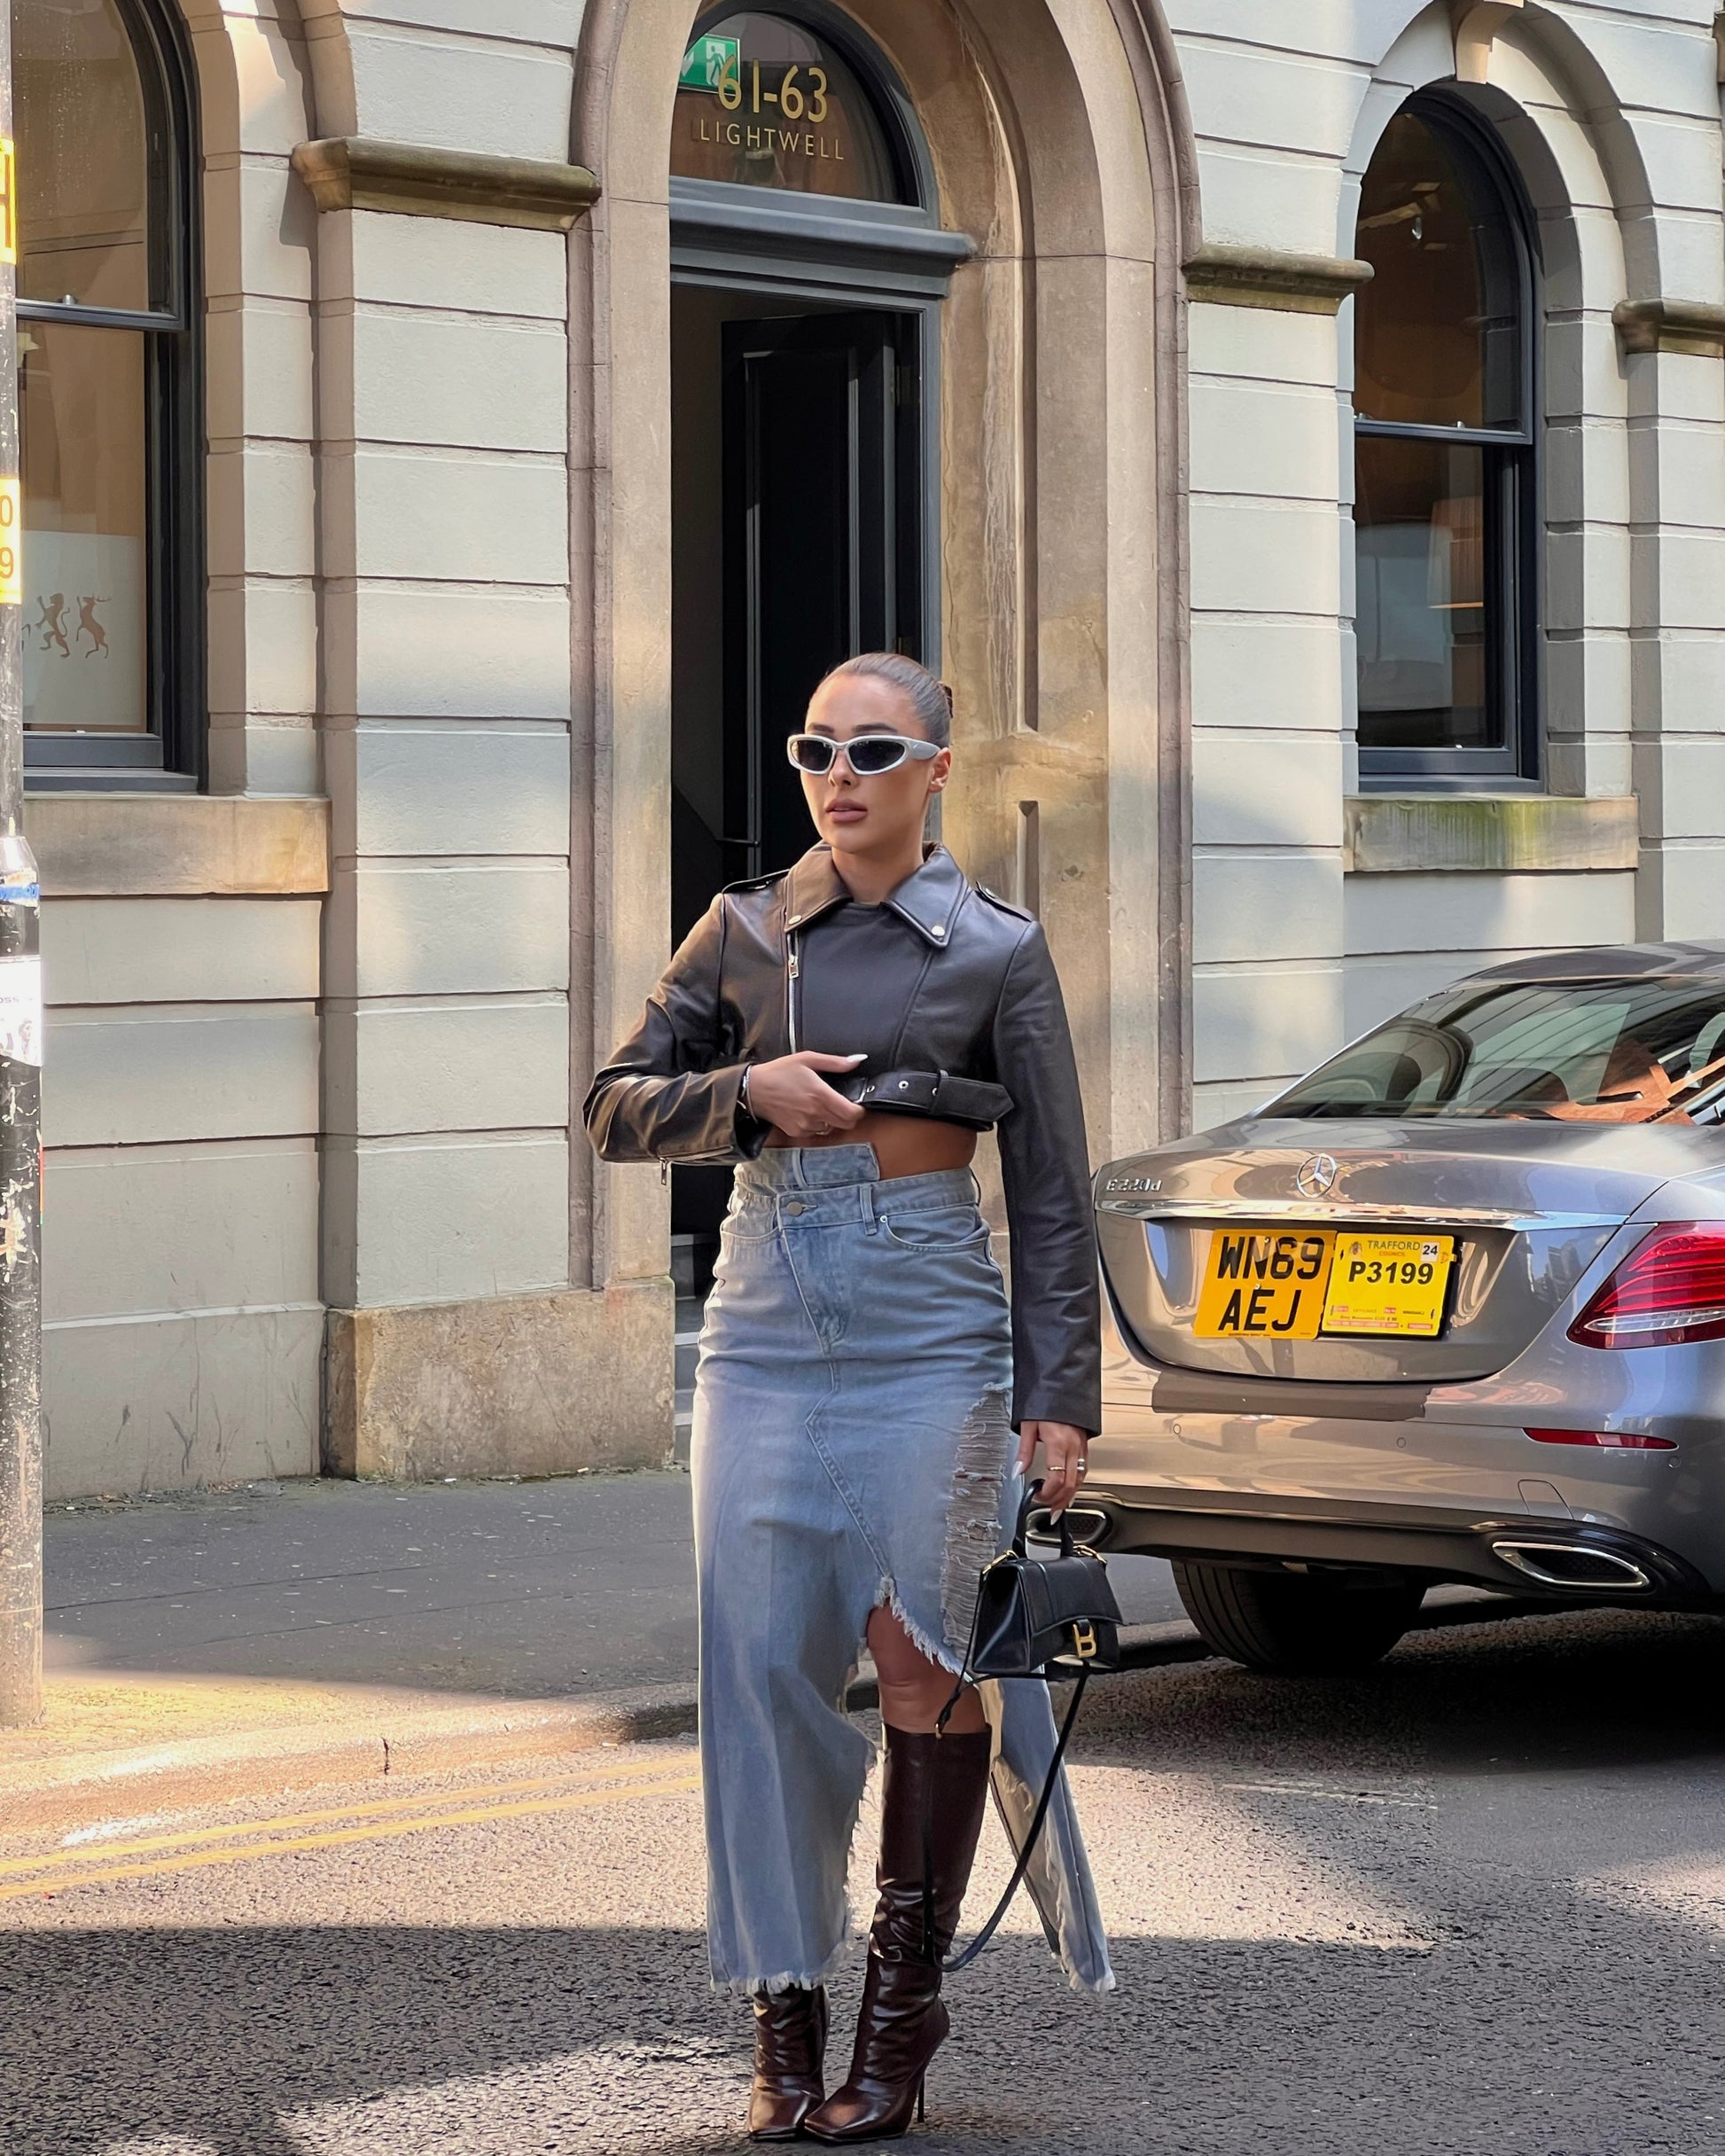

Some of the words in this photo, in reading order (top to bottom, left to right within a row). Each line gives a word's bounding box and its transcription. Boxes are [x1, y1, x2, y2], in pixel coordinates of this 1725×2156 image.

[718, 55, 828, 123] 61-63
[699, 118, 845, 160] LIGHTWELL
[1217, 1236, 1325, 1280] WN69
[1368, 1239, 1421, 1252] TRAFFORD
[1422, 1244, 1438, 1256] 24
[1348, 1261, 1434, 1285] P3199
[1217, 1288, 1302, 1332] AEJ
